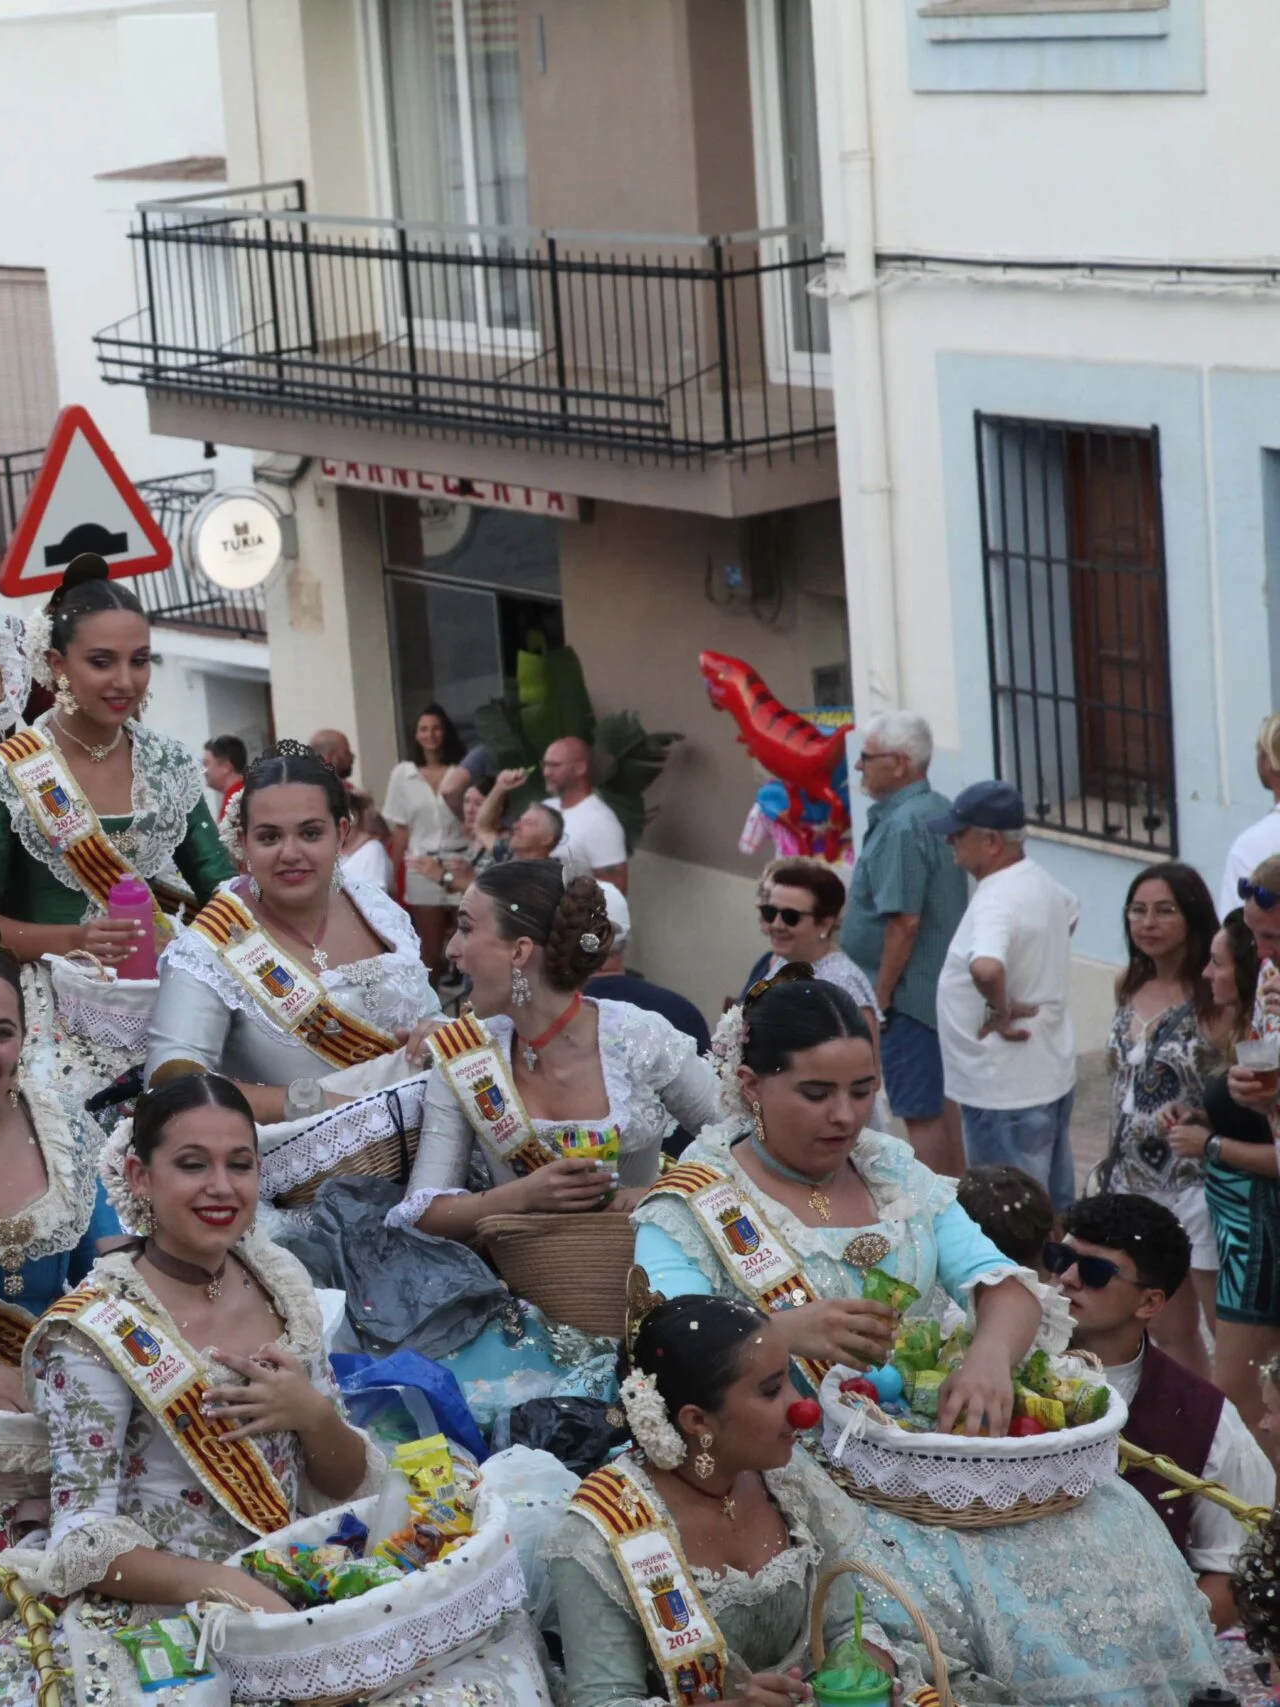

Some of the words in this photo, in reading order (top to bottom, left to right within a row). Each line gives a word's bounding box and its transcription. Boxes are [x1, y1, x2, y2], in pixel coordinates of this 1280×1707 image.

[221, 533, 264, 552] TURIA
[20, 760, 54, 777] FOGUERES
[54, 811, 81, 831] 2023
[236, 943, 268, 965] FOGUERES
[281, 986, 307, 1011] 2023
[455, 1056, 492, 1077] FOGUERES
[491, 1114, 514, 1137] 2023
[697, 1187, 733, 1208] FOGUERES
[740, 1247, 773, 1271] 2023
[146, 1354, 175, 1384] 2023
[631, 1551, 672, 1570] FOGUERES
[666, 1628, 702, 1650] 2023
